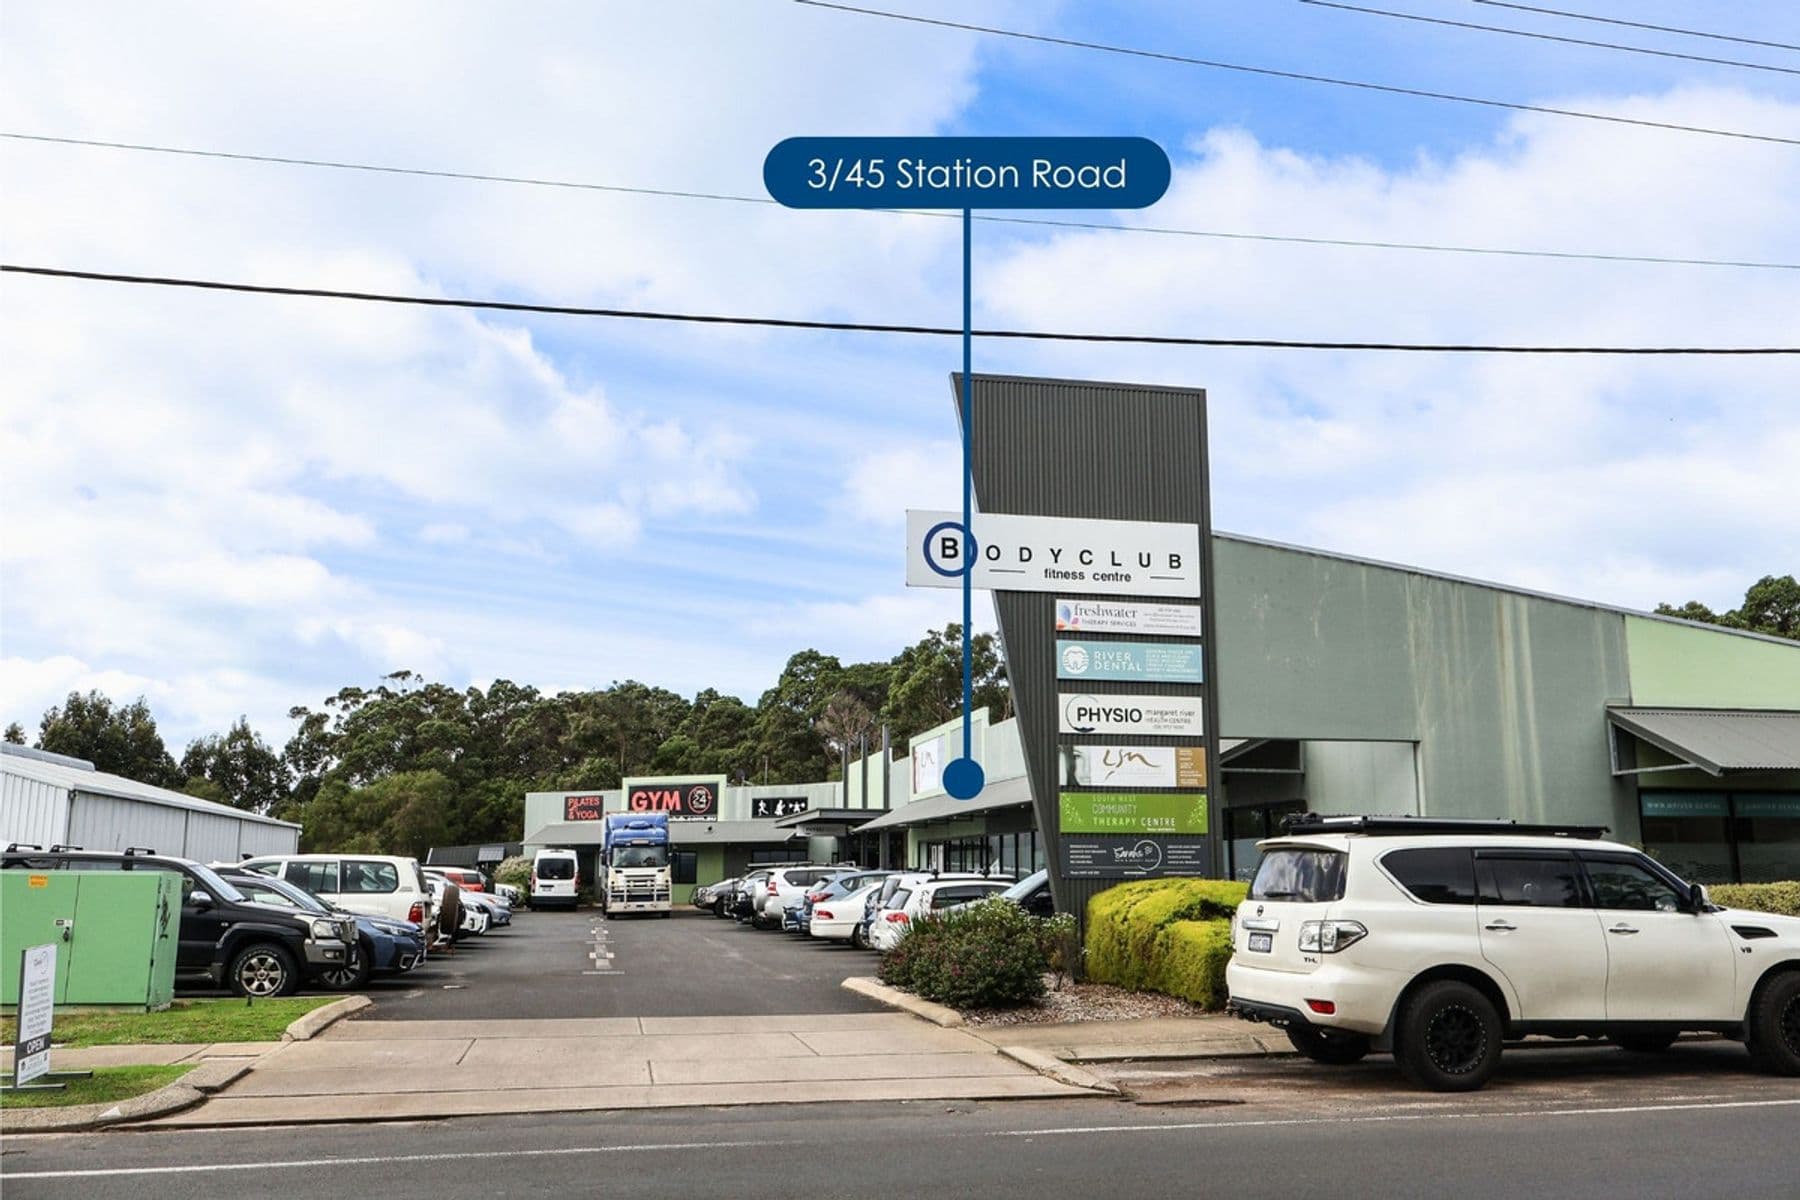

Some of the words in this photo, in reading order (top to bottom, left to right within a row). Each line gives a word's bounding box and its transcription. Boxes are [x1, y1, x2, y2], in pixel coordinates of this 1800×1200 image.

[1044, 568, 1086, 580] fitness
[1092, 571, 1132, 583] centre
[1074, 603, 1138, 618] freshwater
[1094, 650, 1132, 661] RIVER
[1094, 661, 1143, 672] DENTAL
[1077, 707, 1143, 723] PHYSIO
[631, 790, 682, 812] GYM
[575, 810, 600, 820] YOGA
[1093, 816, 1137, 826] THERAPY
[1140, 816, 1176, 827] CENTRE
[27, 1037, 45, 1054] OPEN
